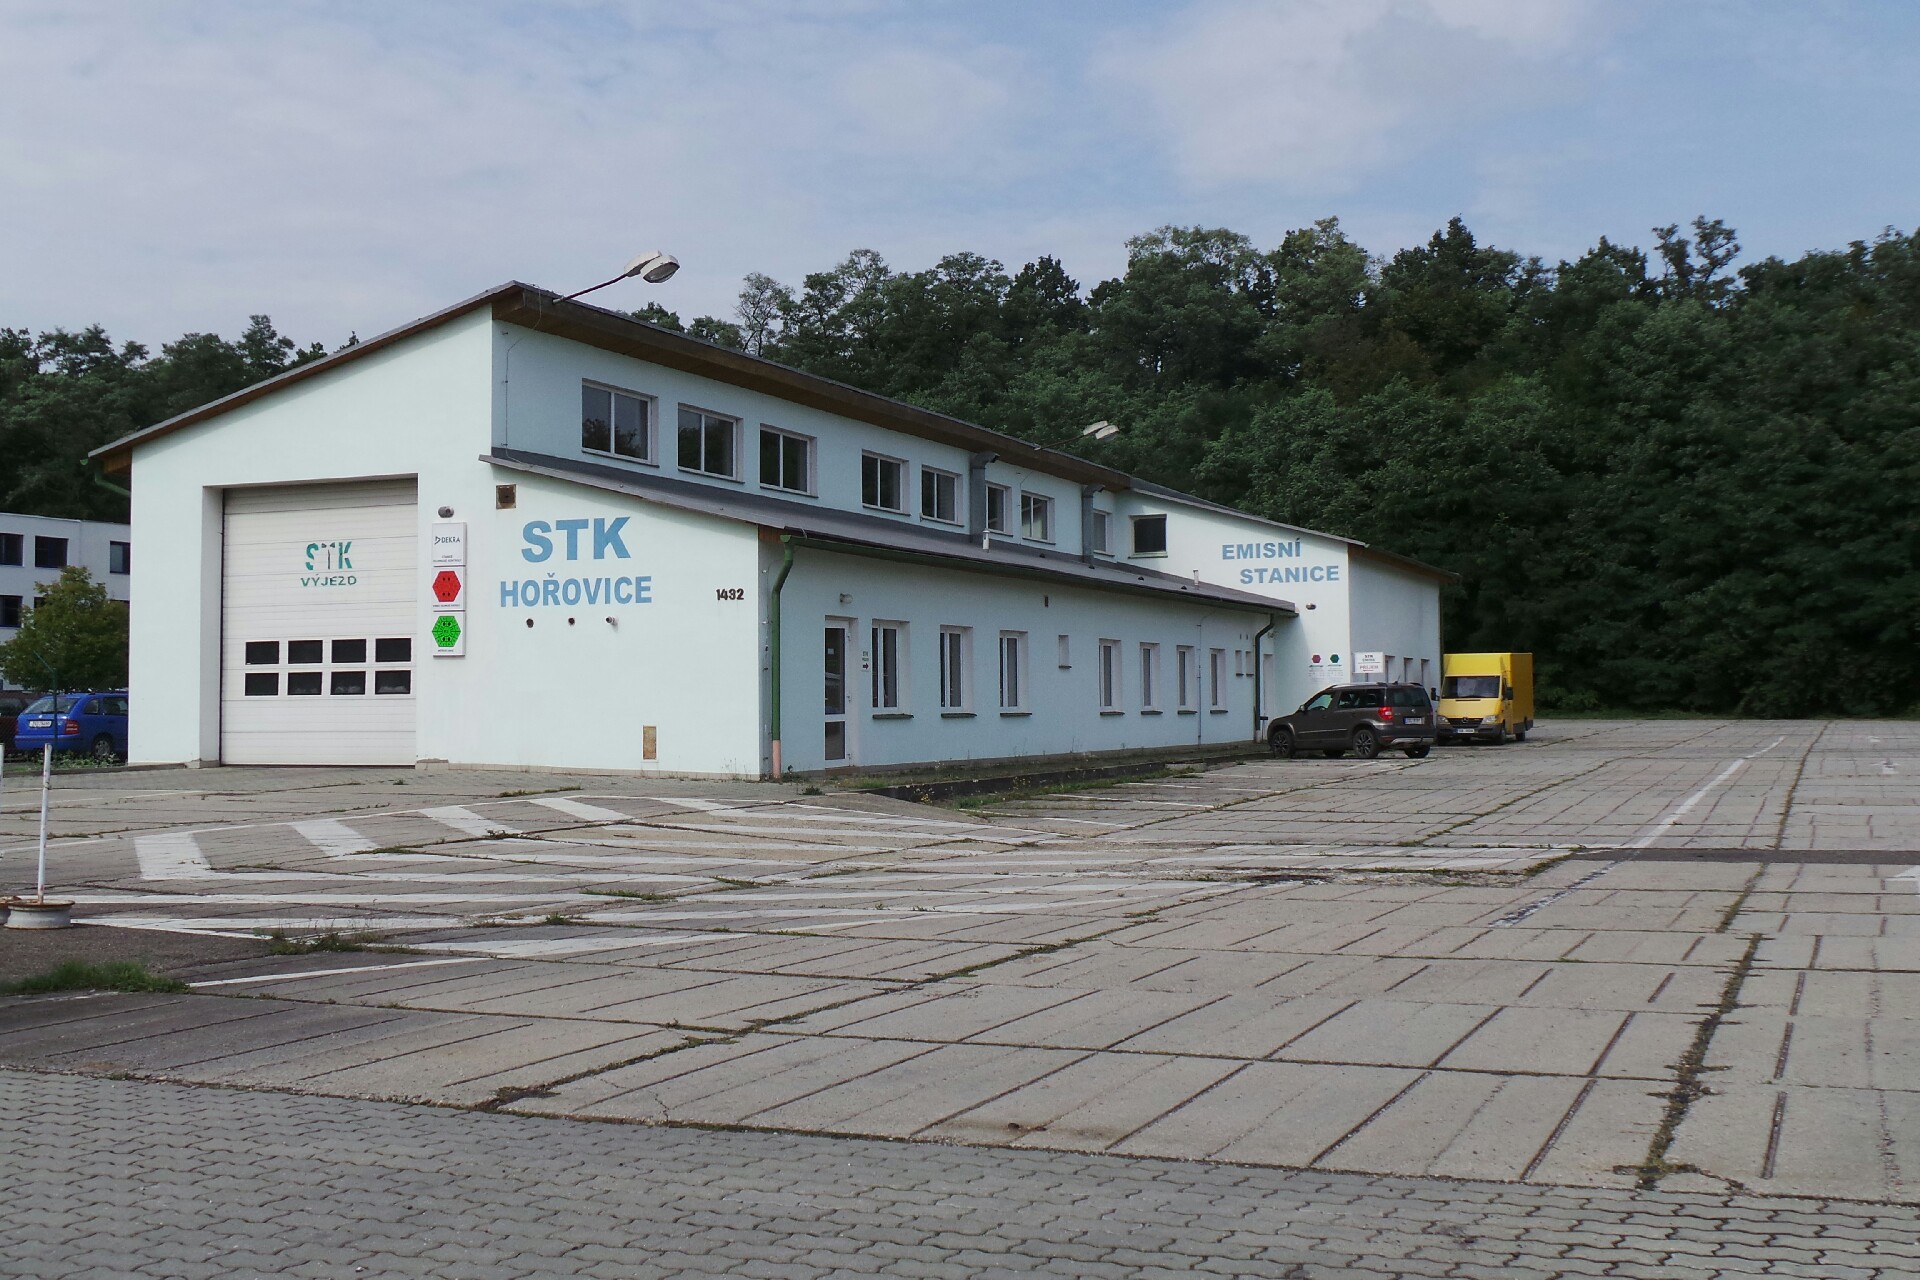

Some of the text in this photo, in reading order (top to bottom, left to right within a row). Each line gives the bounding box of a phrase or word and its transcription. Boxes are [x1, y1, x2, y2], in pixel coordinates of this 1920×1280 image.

[520, 516, 632, 563] STK
[1222, 537, 1301, 560] EMISNÍ
[305, 541, 353, 570] STK
[300, 573, 357, 587] VÝJEZD
[1240, 565, 1340, 585] STANICE
[500, 572, 652, 608] HOŘOVICE
[715, 588, 745, 601] 1432
